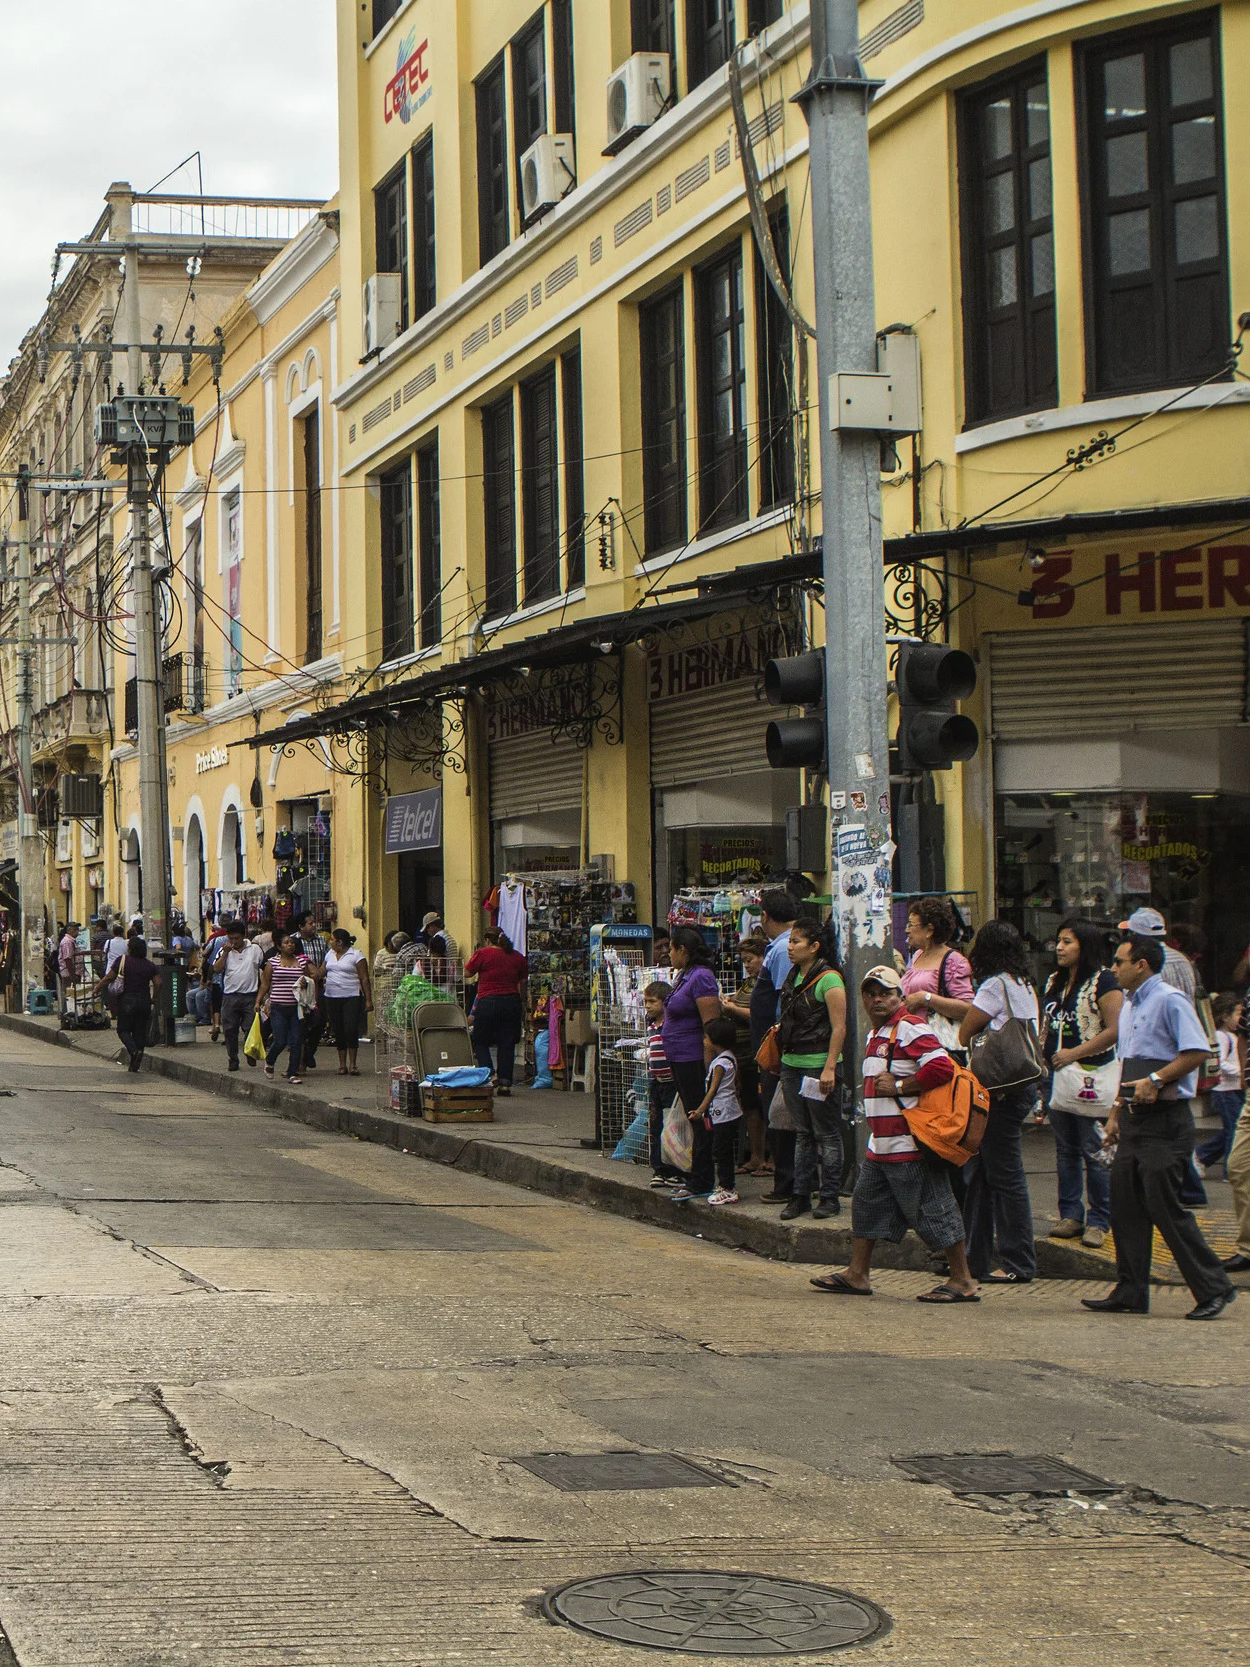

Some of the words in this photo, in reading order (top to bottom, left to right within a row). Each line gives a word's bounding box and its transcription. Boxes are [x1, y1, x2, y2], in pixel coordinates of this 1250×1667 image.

[1031, 549, 1076, 620] 3
[668, 622, 798, 696] HERMANO
[400, 798, 439, 843] telcel
[723, 839, 755, 847] PRECIOS
[611, 928, 648, 937] MONEDAS
